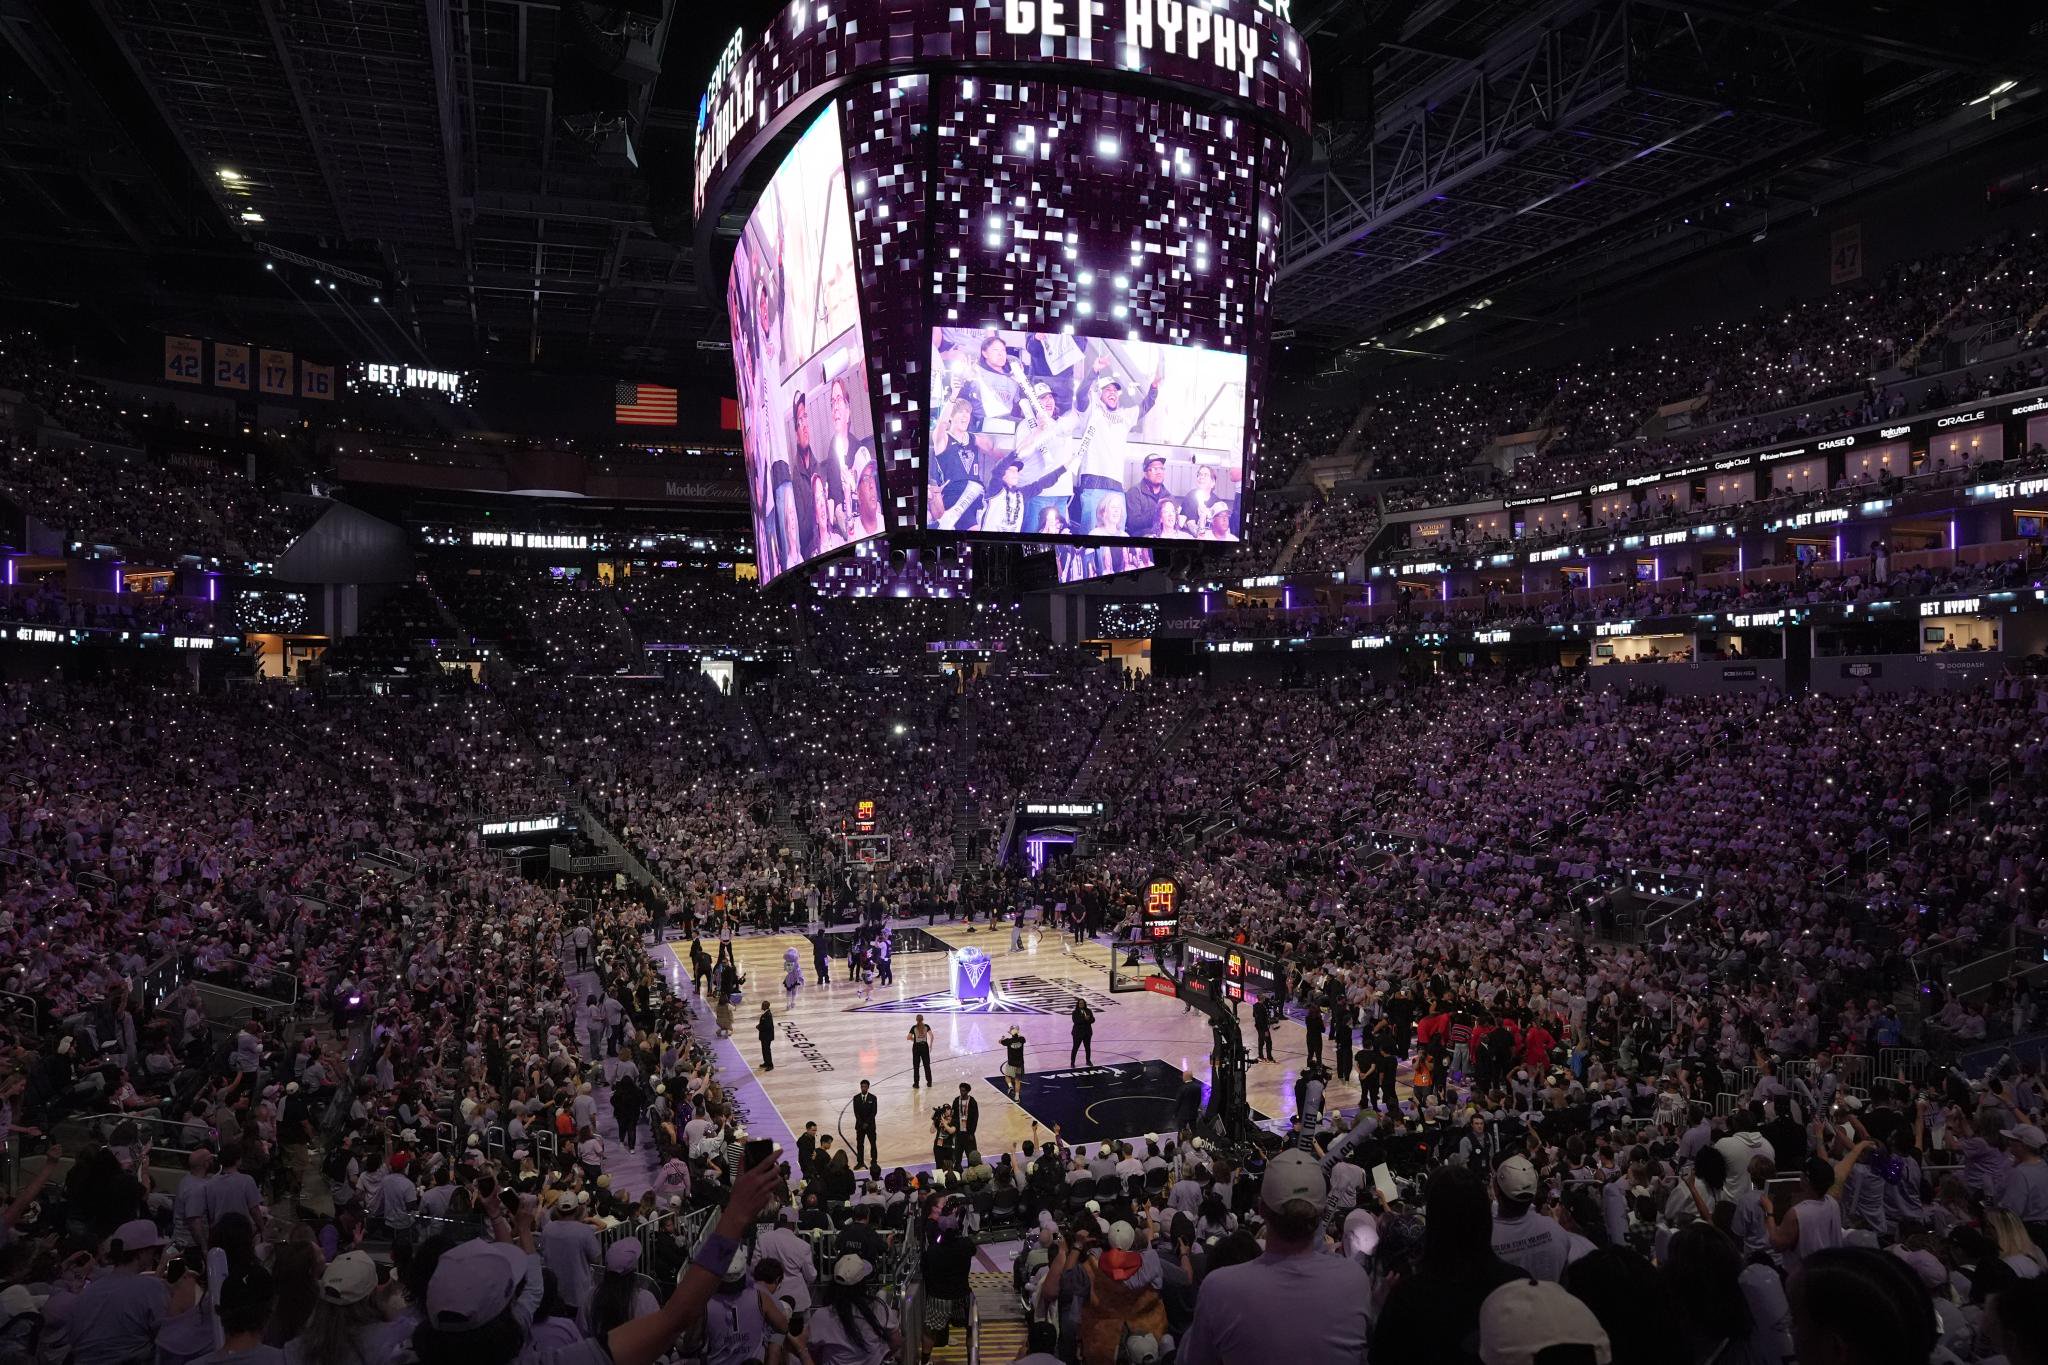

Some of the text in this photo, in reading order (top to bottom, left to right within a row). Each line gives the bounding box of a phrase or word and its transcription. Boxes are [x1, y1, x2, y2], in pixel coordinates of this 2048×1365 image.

[1125, 0, 1258, 78] HYPHY
[706, 26, 742, 114] CENTER
[168, 353, 199, 378] 42
[218, 360, 247, 384] 24
[266, 366, 287, 389] 17
[306, 371, 329, 394] 16
[367, 364, 459, 392] GET HYPHY
[1937, 411, 1984, 427] ORACLE
[1880, 425, 1910, 439] Rakuten
[1818, 438, 1846, 450] CHASE
[1714, 456, 1750, 472] Google Cloud
[1598, 482, 1618, 493] PEPSI
[1626, 473, 1661, 487] RingCentral
[665, 480, 706, 497] Modelo
[1995, 483, 2016, 499] GET
[1796, 508, 1844, 526] GET HYPHY
[472, 532, 508, 547] HYPHY
[511, 533, 524, 548] IN
[1650, 531, 1687, 547] GET HYPHY
[1529, 552, 1540, 563] GET
[1920, 598, 1980, 616] GET HYPHY
[1166, 616, 1208, 630] veriz
[1734, 612, 1780, 628] GET HYPHY
[19, 628, 57, 642] GET HYPHY
[1479, 632, 1491, 643] GET
[1596, 623, 1632, 636] GET HYPHY
[174, 637, 214, 649] GET HYPHY
[1915, 655, 1927, 663] 104
[858, 807, 872, 819] 24
[1151, 883, 1174, 894] 10:00
[1149, 894, 1171, 913] 24
[1154, 919, 1178, 927] TISSOT
[1154, 926, 1170, 936] 0:37
[777, 1021, 835, 1073] CHASE CENTER
[1040, 1068, 1110, 1080] WNBA
[1303, 1113, 1317, 1130] GO
[731, 1305, 739, 1333] 1
